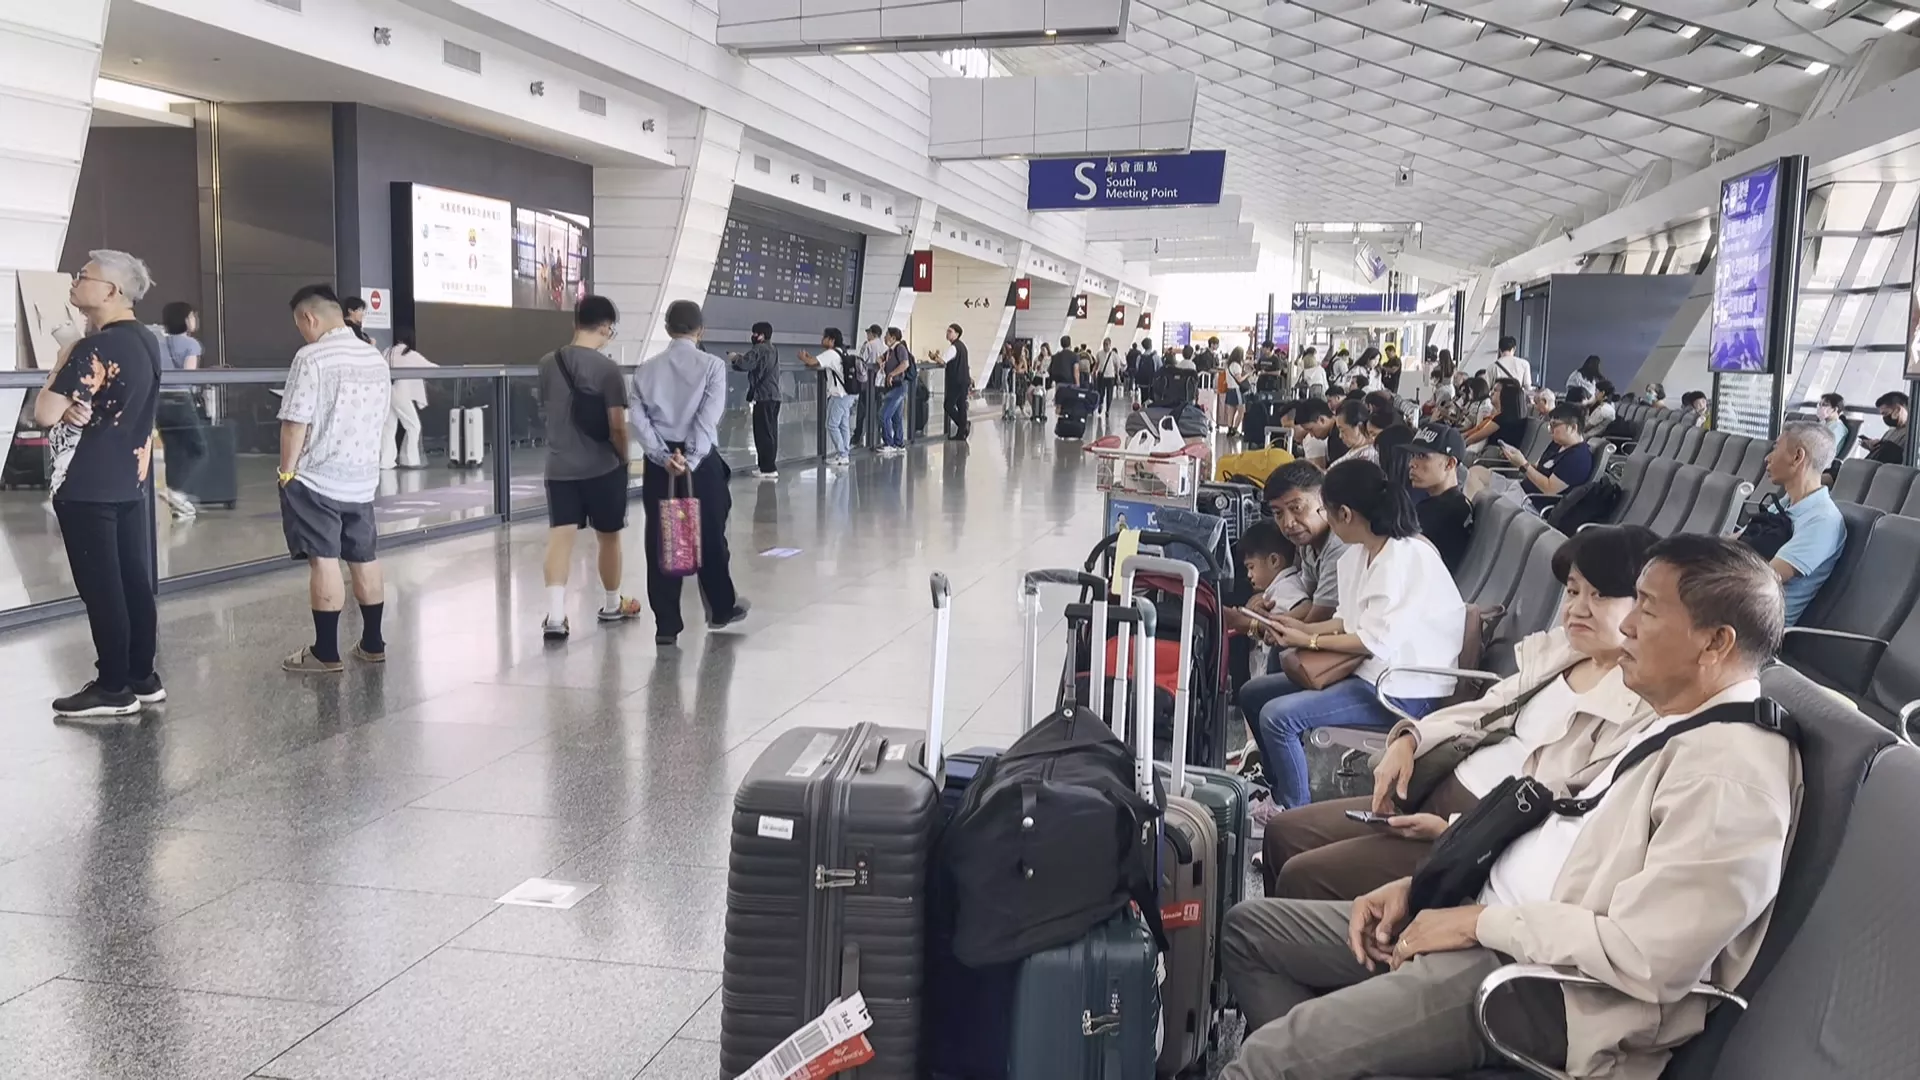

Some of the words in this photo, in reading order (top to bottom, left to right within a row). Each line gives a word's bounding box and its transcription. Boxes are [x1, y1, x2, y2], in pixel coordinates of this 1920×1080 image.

[1074, 161, 1098, 201] S
[1106, 176, 1137, 188] South
[1105, 188, 1149, 201] Meeting
[1151, 187, 1178, 199] Point
[839, 1010, 854, 1030] TPE
